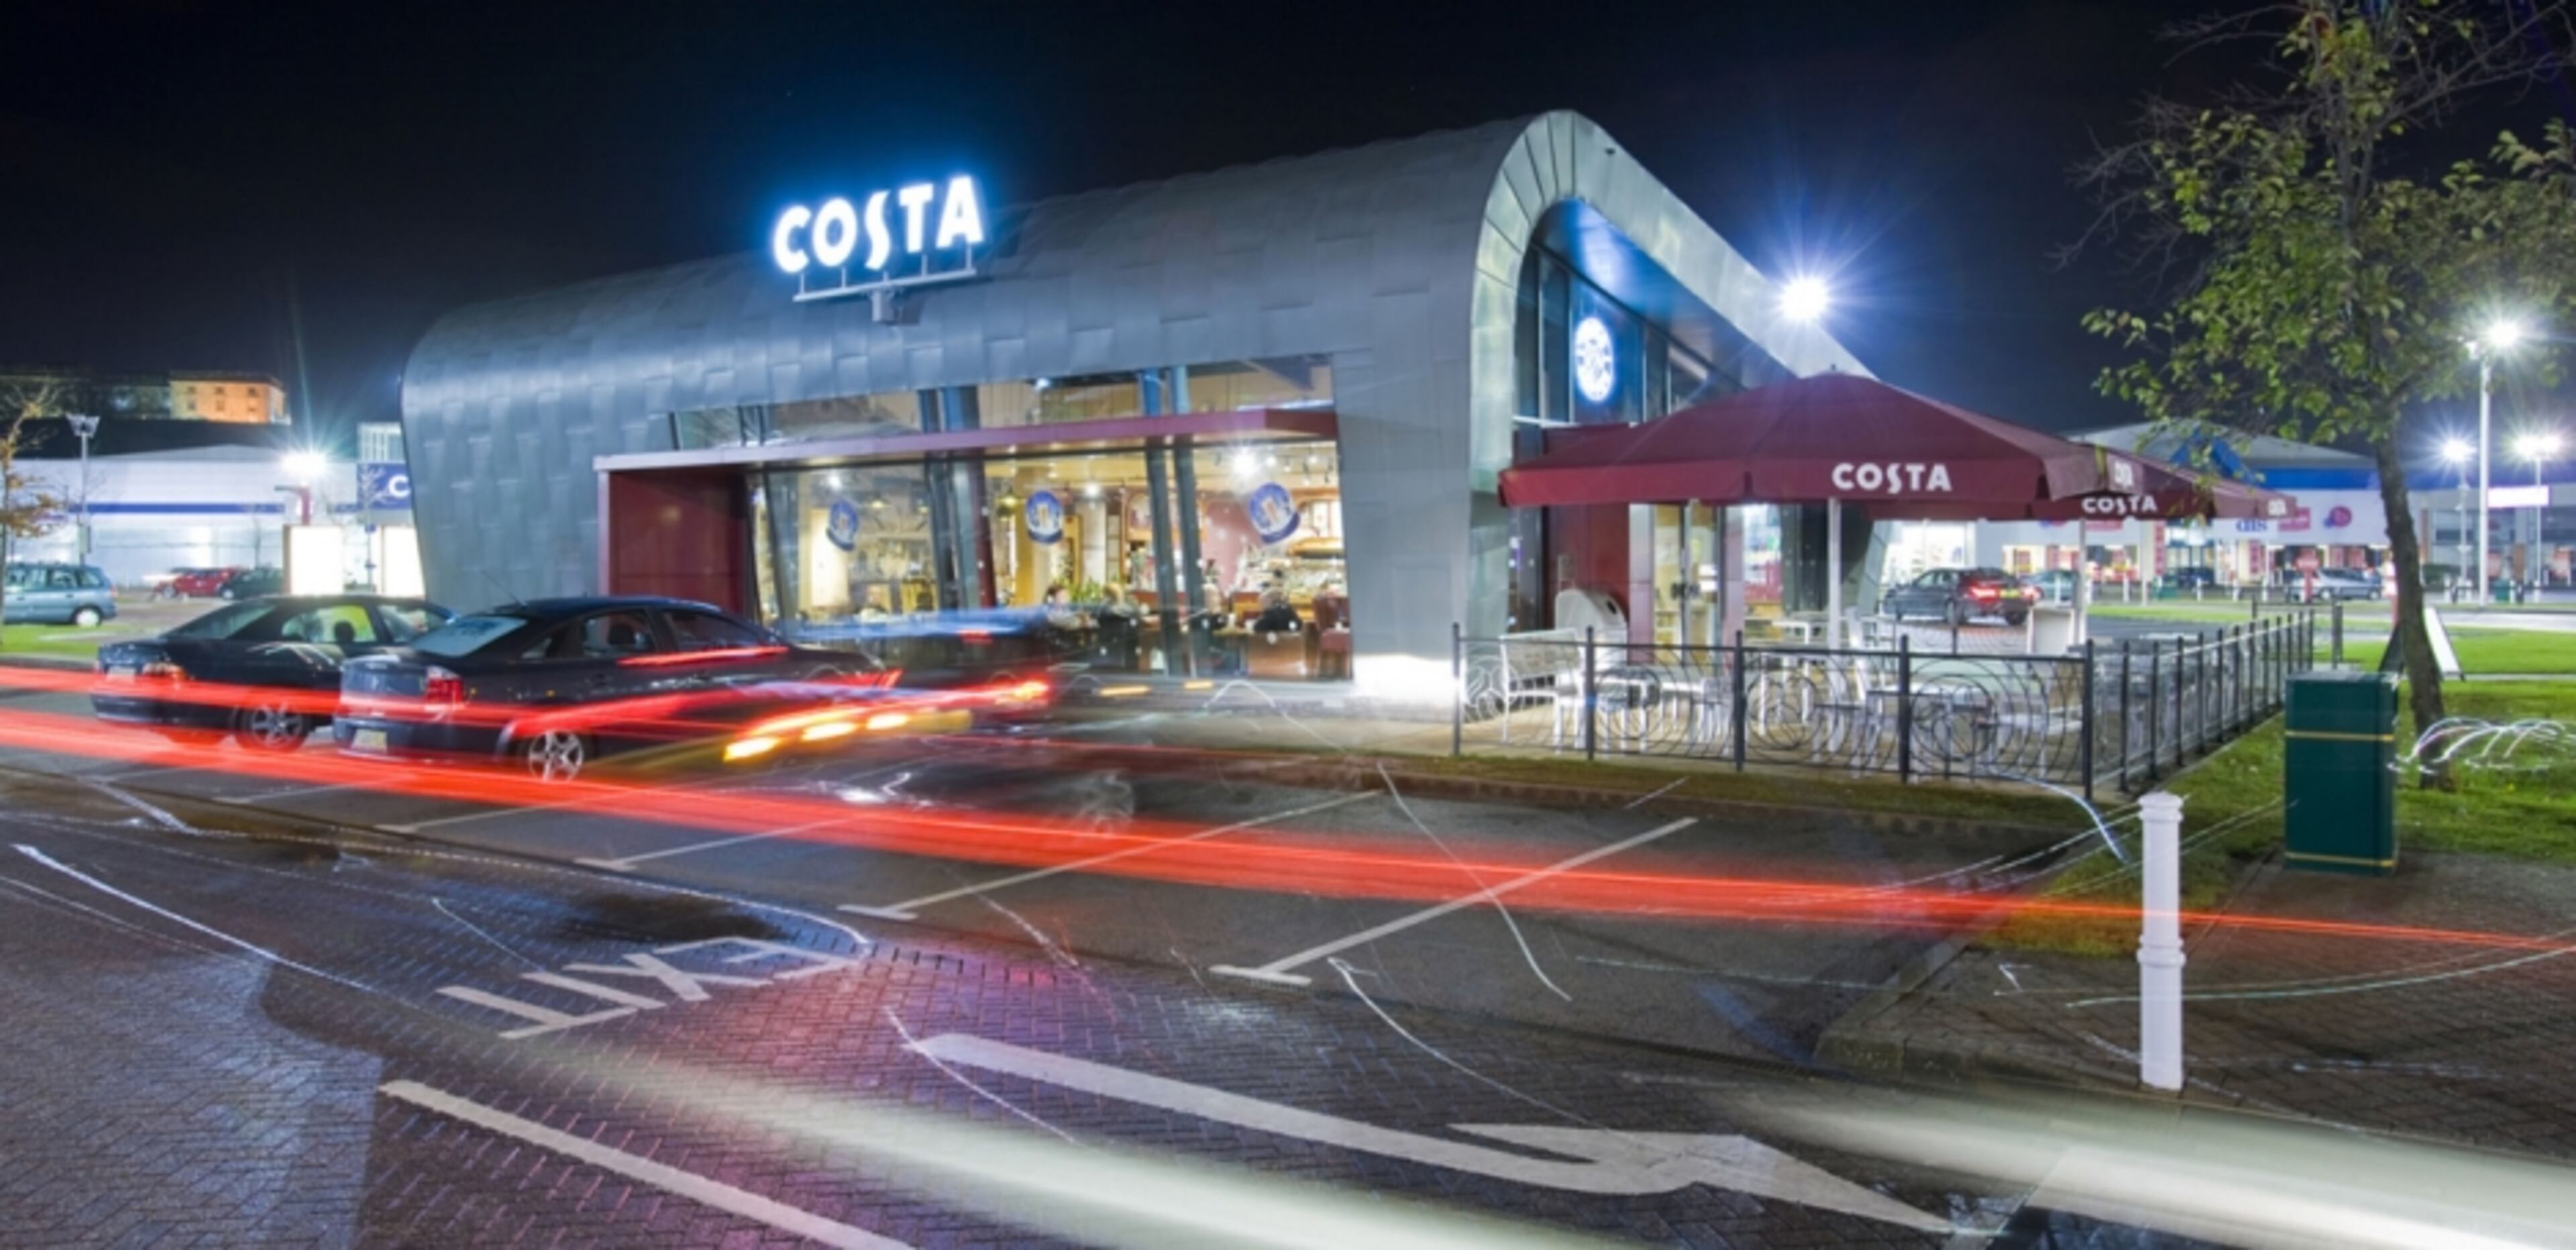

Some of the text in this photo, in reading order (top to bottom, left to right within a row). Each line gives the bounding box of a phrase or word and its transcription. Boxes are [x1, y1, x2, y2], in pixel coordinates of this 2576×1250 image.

[773, 174, 984, 273] COSTA
[1831, 462, 1952, 494] COSTA
[2082, 495, 2158, 515] COSTA
[434, 936, 861, 1041] EXIT
